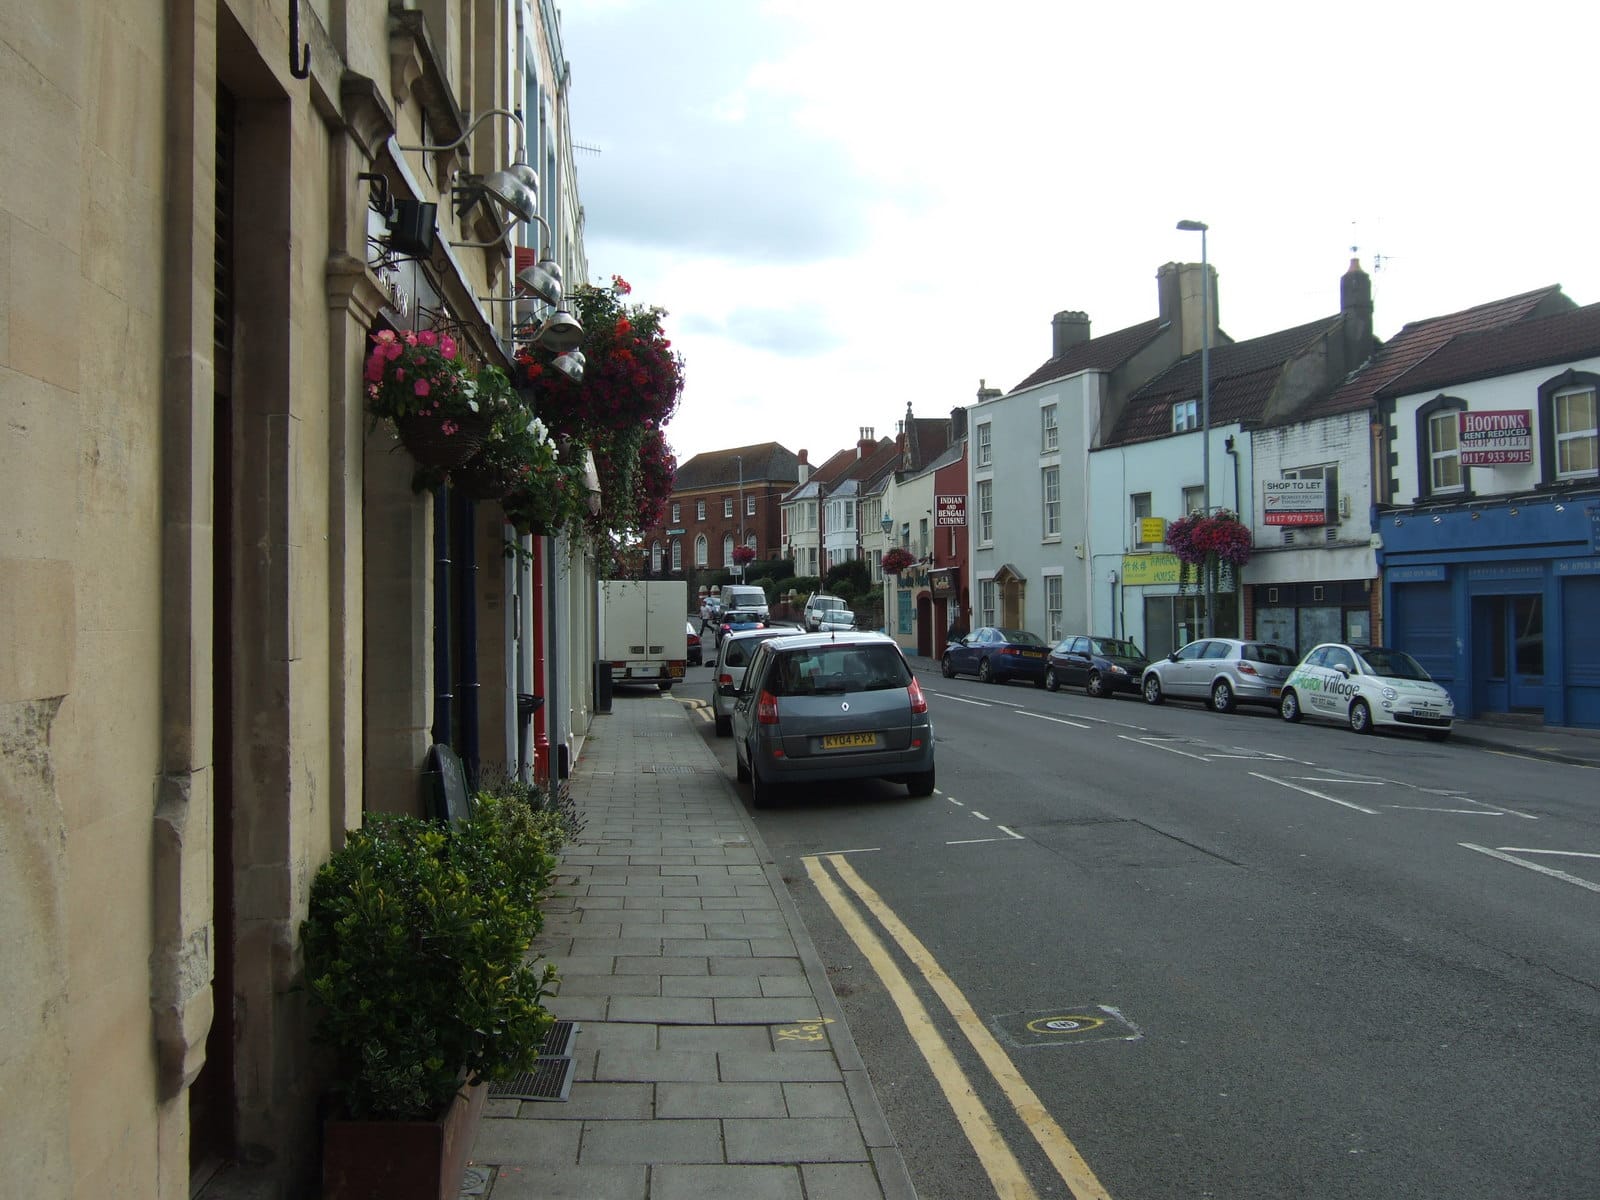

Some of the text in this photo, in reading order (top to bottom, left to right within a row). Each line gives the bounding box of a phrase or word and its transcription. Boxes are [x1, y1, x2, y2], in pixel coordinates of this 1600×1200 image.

[1465, 414, 1525, 432] HOOTONS
[1464, 428, 1527, 440] RENT REDUCED
[1462, 450, 1530, 463] 0117 933 9915
[1267, 482, 1321, 490] SHOP TO LET
[940, 497, 963, 505] INDIAN
[938, 509, 965, 517] BENGALI
[939, 517, 965, 525] CUISINE
[1266, 515, 1285, 523] 0117
[1323, 674, 1360, 702] Village
[826, 733, 874, 747] KY04 PXX
